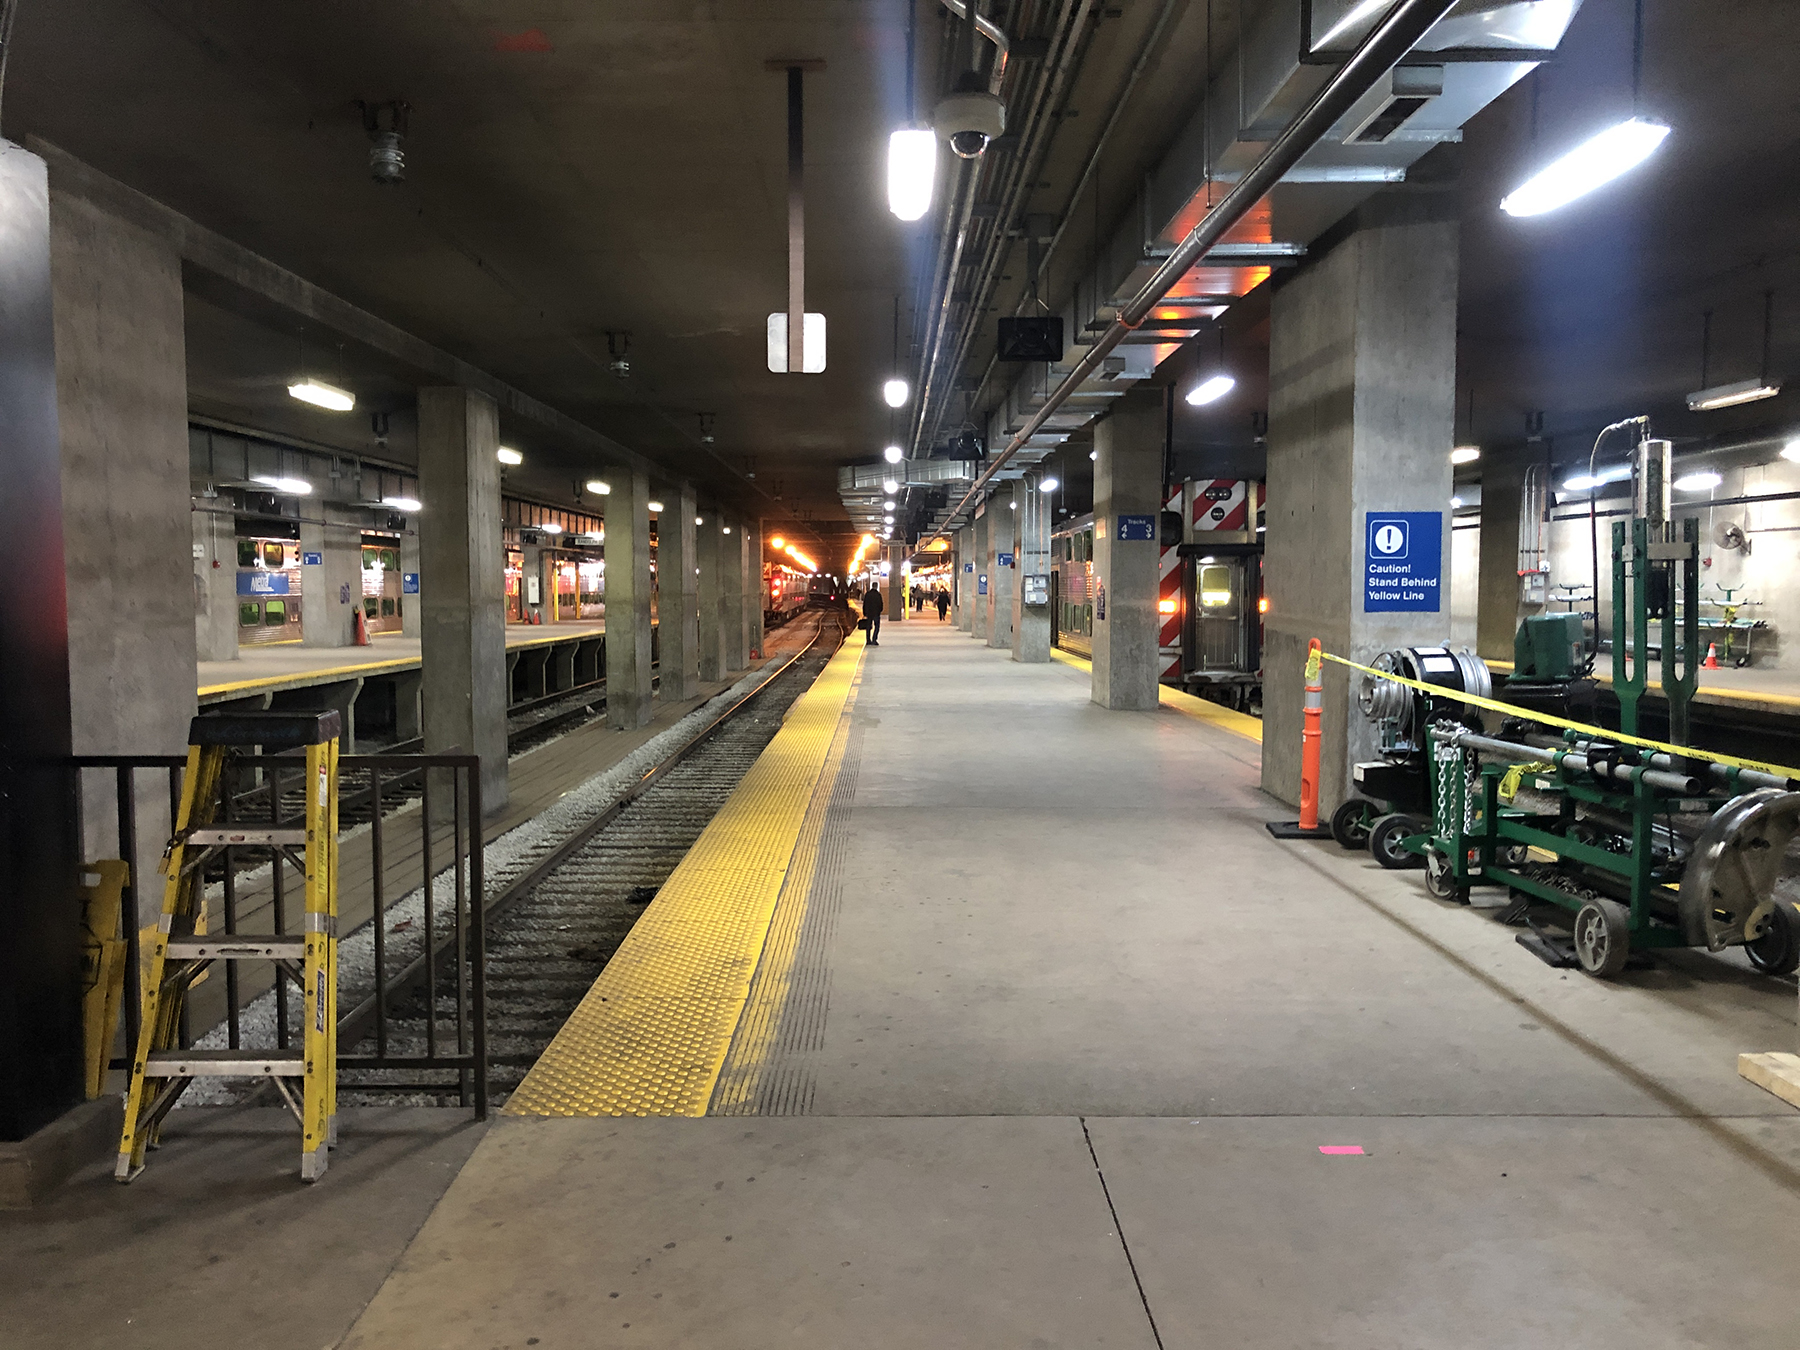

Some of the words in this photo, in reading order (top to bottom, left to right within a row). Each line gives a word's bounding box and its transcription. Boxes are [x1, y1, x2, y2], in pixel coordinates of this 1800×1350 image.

[1121, 524, 1128, 533] 4
[1145, 524, 1152, 533] 3
[1369, 564, 1411, 573] Caution!
[1368, 577, 1398, 587] Stand
[1401, 577, 1437, 587] Behind
[1368, 591, 1401, 600] Yellow
[1403, 591, 1425, 600] Line
